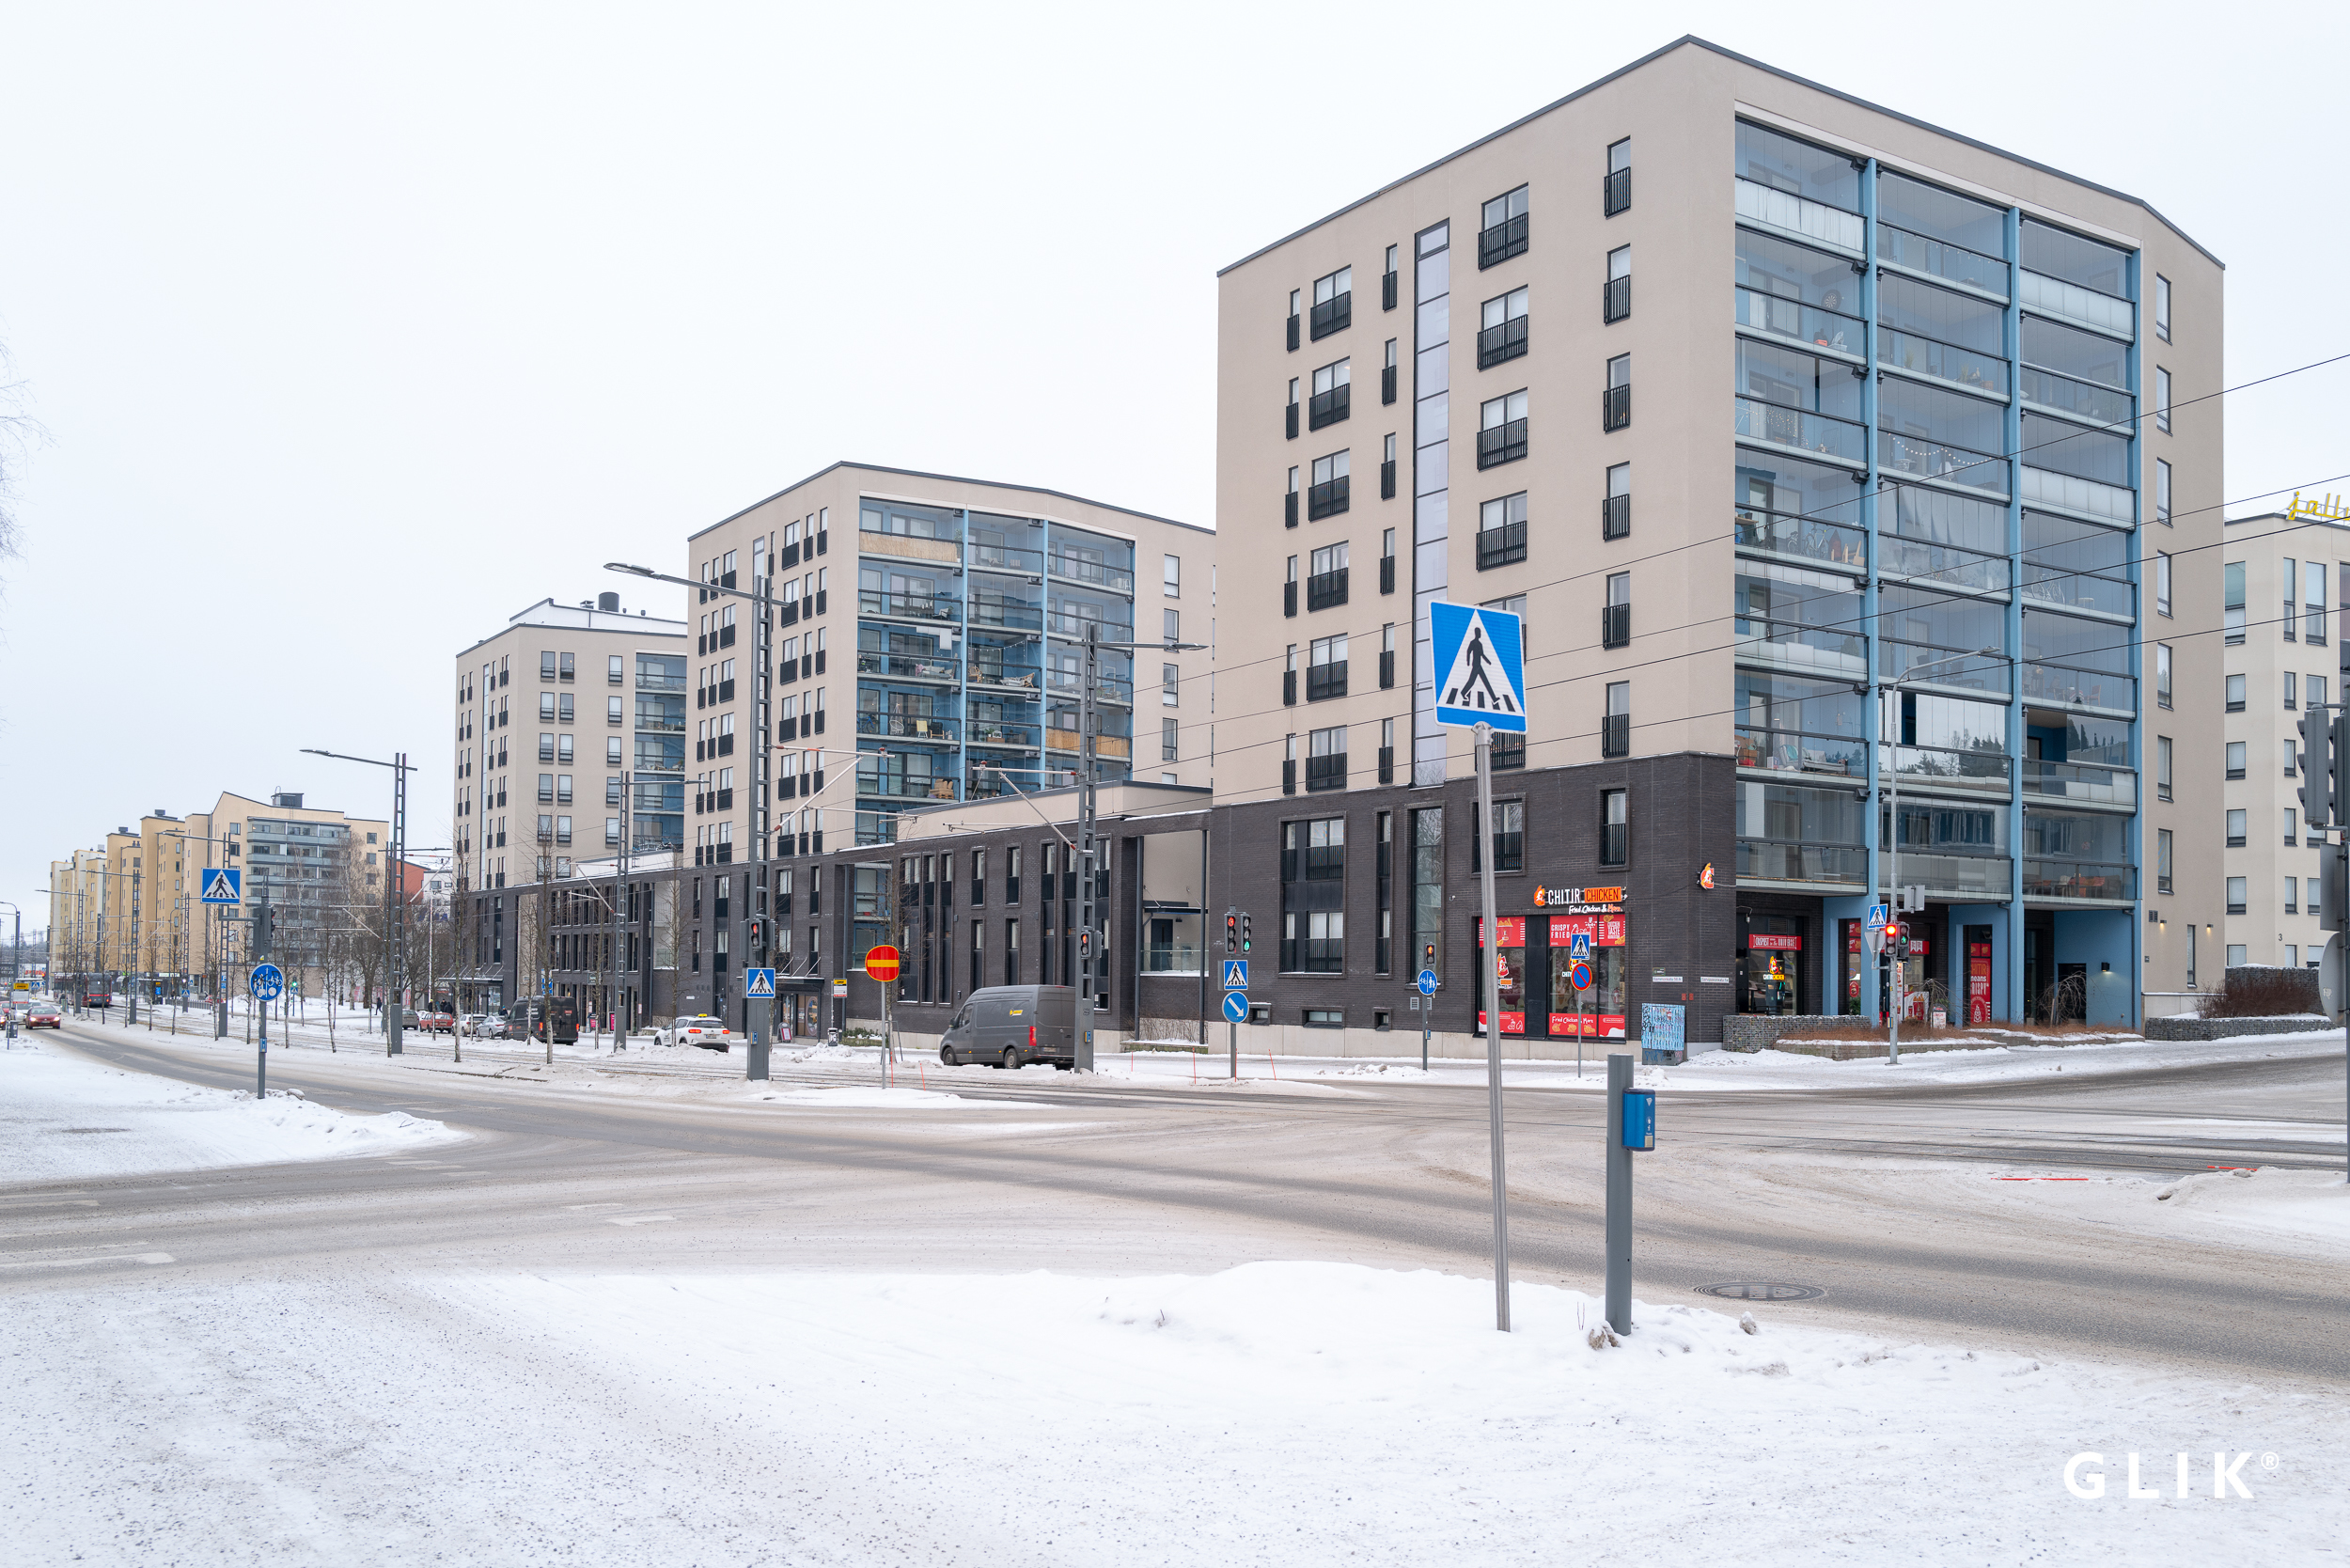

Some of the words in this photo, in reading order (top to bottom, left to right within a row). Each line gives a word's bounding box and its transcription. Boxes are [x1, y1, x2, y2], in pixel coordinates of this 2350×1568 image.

[1548, 888, 1580, 905] CHITIR
[1586, 888, 1620, 902] CHICKEN
[1569, 904, 1582, 915] Fried
[1582, 905, 1601, 914] Chicken
[1551, 931, 1570, 939] FRIED
[2278, 933, 2283, 941] 3
[1971, 964, 1987, 975] HITIR
[1551, 1015, 1562, 1024] Fried
